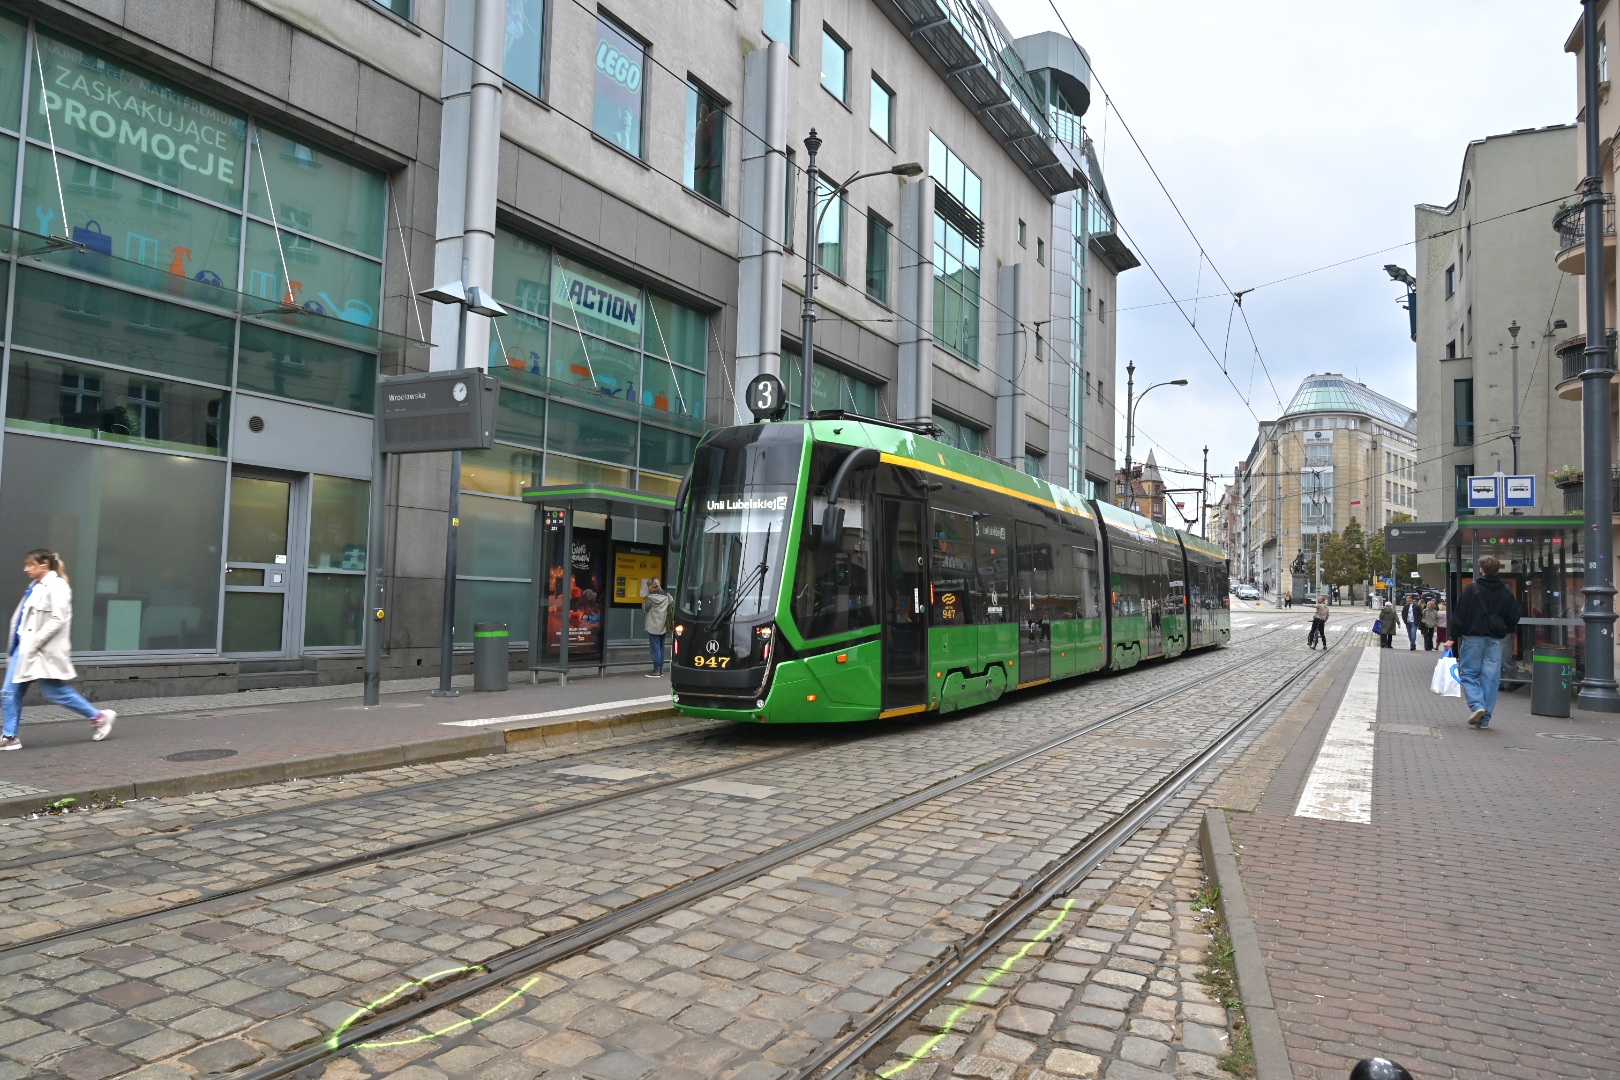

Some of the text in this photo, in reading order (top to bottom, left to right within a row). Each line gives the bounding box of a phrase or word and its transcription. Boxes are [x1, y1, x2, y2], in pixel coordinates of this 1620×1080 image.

[596, 40, 641, 92] LEGO
[55, 65, 228, 151] ZASKAKUJĄCE
[106, 69, 134, 86] CENY
[139, 80, 180, 105] MARKI
[184, 95, 239, 130] PREMIUM
[39, 88, 235, 185] PROMOCJE
[567, 279, 637, 326] ACTION
[757, 381, 772, 409] 3
[707, 498, 777, 511] Unii Lubelskiej
[942, 610, 956, 618] 947
[694, 656, 730, 668] 947
